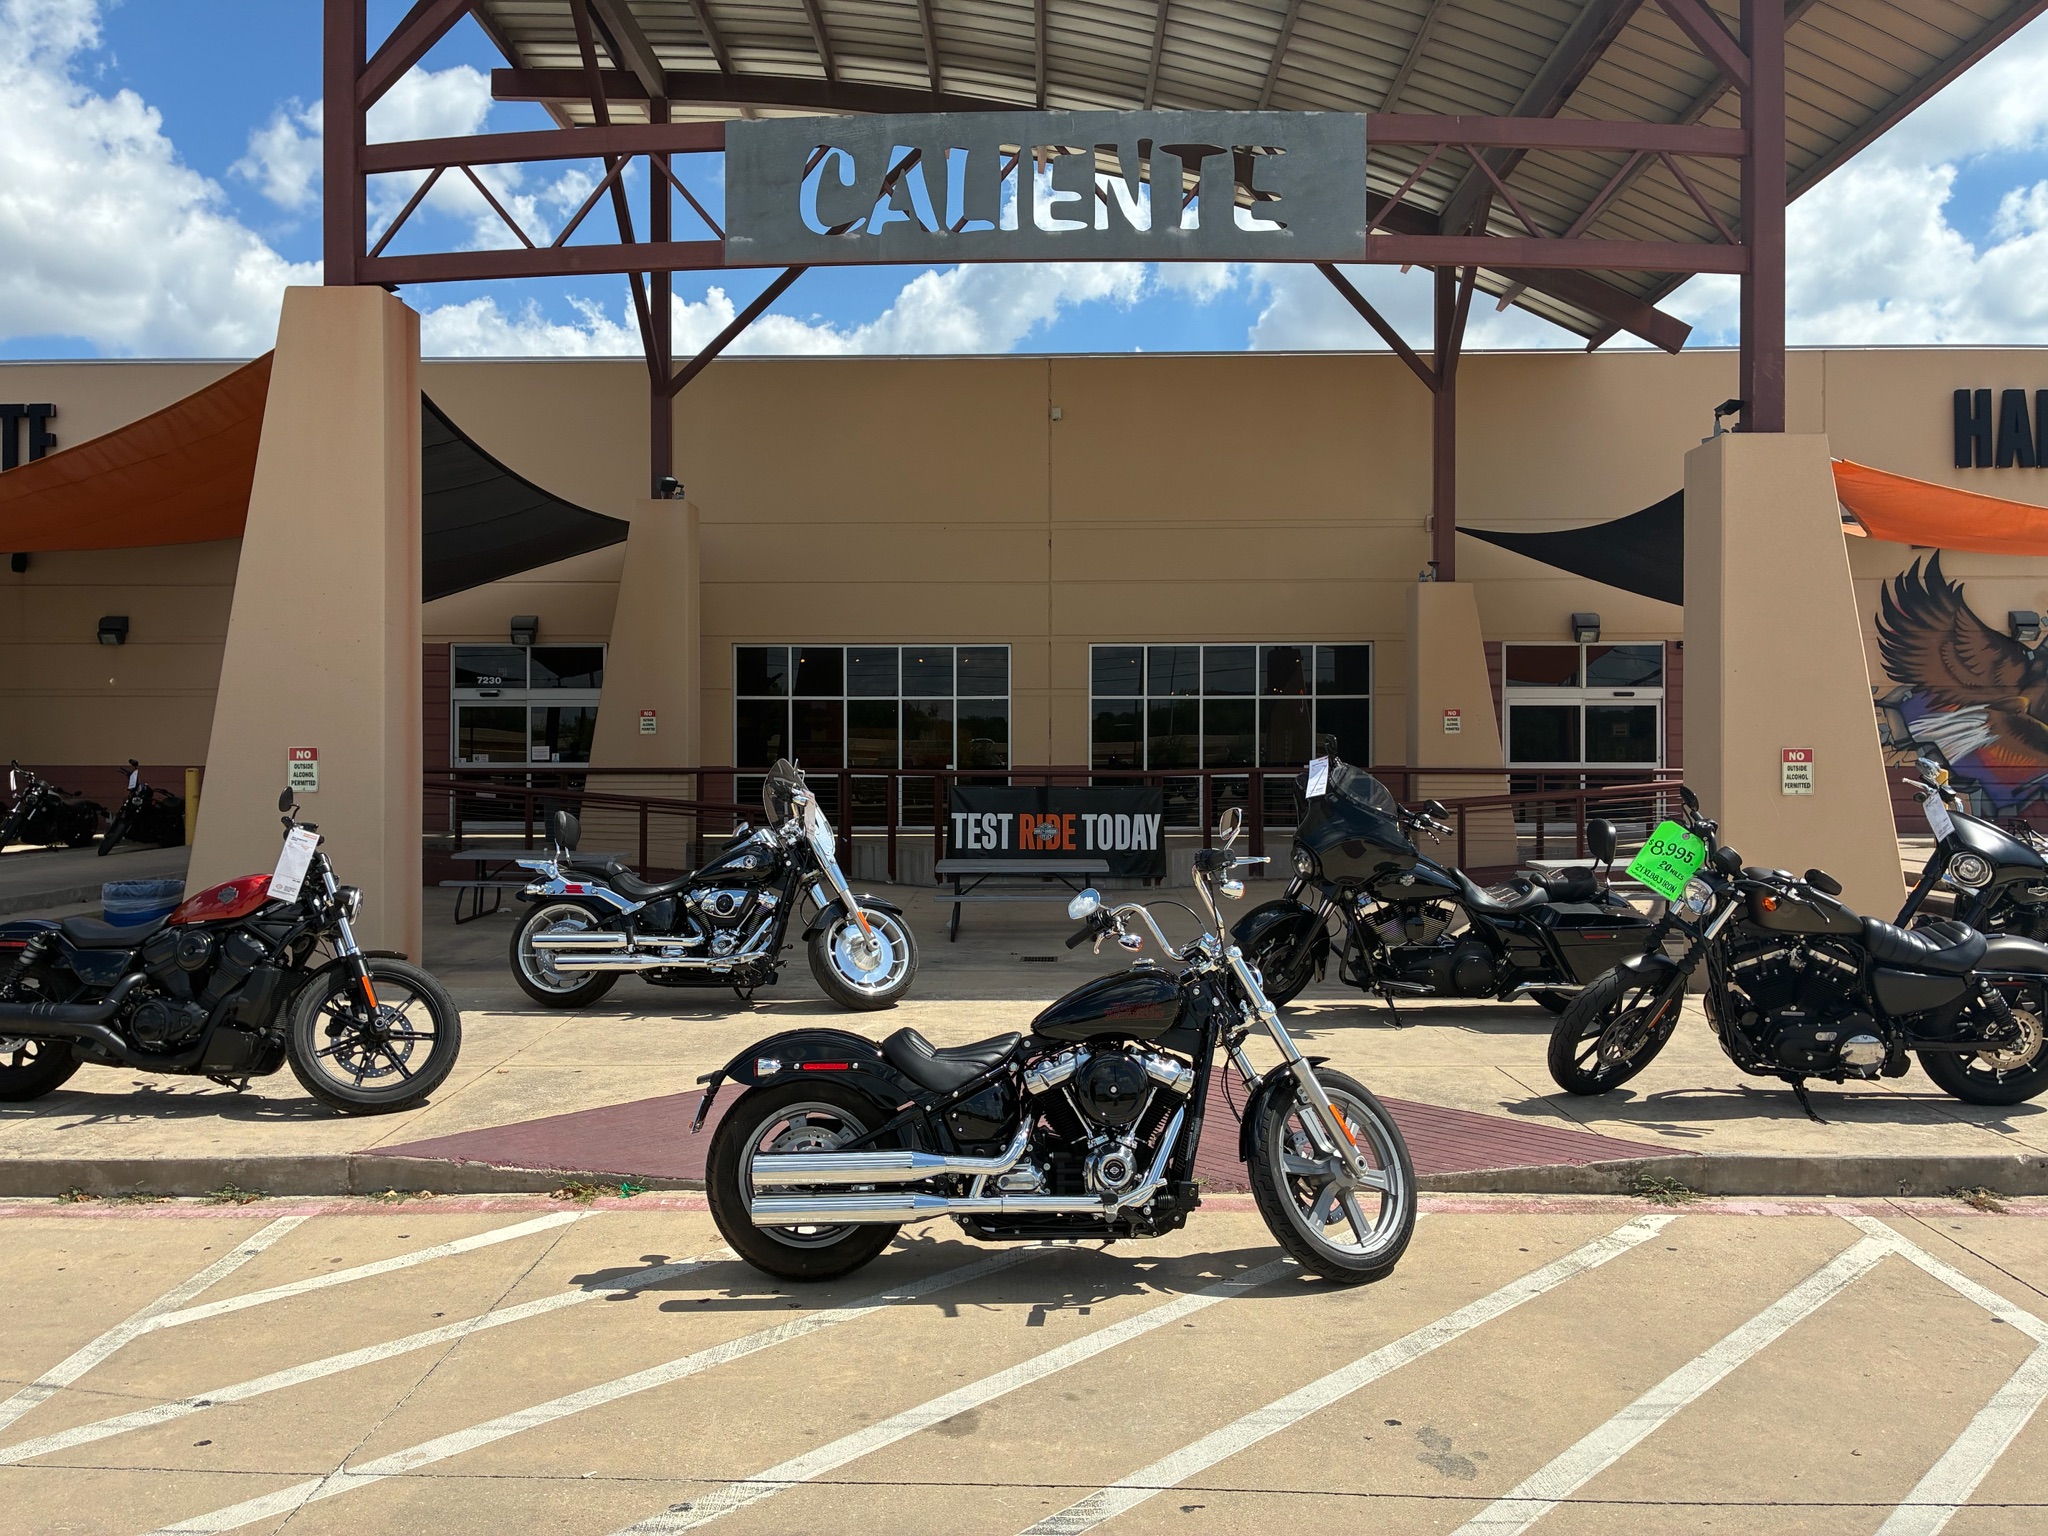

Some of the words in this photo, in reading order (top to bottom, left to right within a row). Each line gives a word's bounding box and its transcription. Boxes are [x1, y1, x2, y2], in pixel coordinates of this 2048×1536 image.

[799, 138, 1288, 236] CALIENTE
[476, 676, 502, 685] 7230
[296, 750, 312, 759] NO
[1788, 751, 1805, 761] NO
[951, 812, 1013, 850] TEST
[1019, 813, 1077, 850] RIDE
[1081, 813, 1162, 851] TODAY
[1643, 867, 1664, 884] XL883
[1661, 879, 1678, 893] IRON
[1657, 860, 1672, 872] 20
[1669, 868, 1685, 881] MILES
